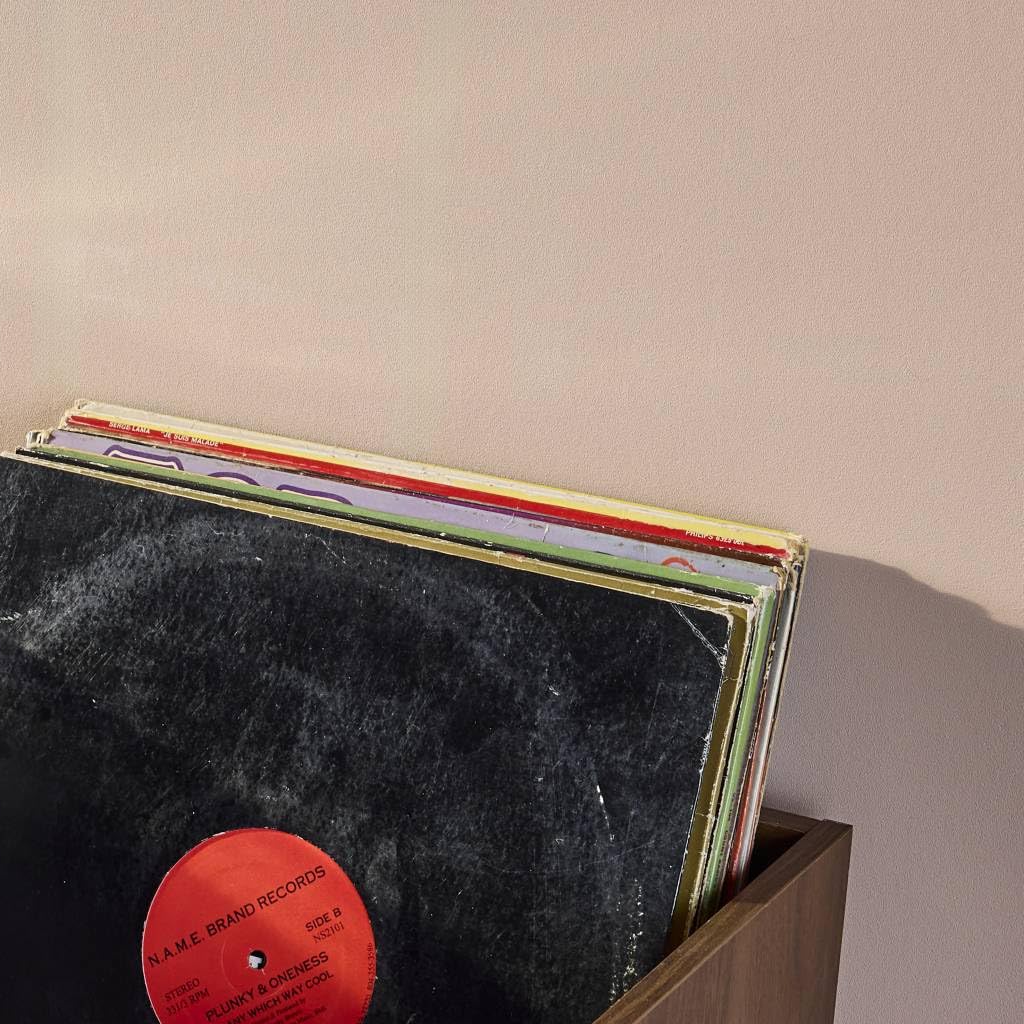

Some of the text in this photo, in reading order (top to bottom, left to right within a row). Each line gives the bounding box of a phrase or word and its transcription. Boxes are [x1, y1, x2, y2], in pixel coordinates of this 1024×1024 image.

[108, 421, 151, 434] SERGE LAMA
[173, 433, 190, 442] SUIS
[685, 530, 714, 540] PHILIPS
[147, 865, 327, 968] N.A.M.E. BRAND RECORDS
[305, 907, 343, 933] SIDE B
[164, 977, 200, 1001] STEREO
[188, 987, 210, 1004] RPM
[205, 988, 254, 1023] PLUNKY
[257, 983, 268, 995] &
[268, 951, 329, 989] ONENESS
[247, 996, 280, 1018] WHICH
[281, 983, 304, 1001] WAY
[305, 970, 334, 989] COOL
